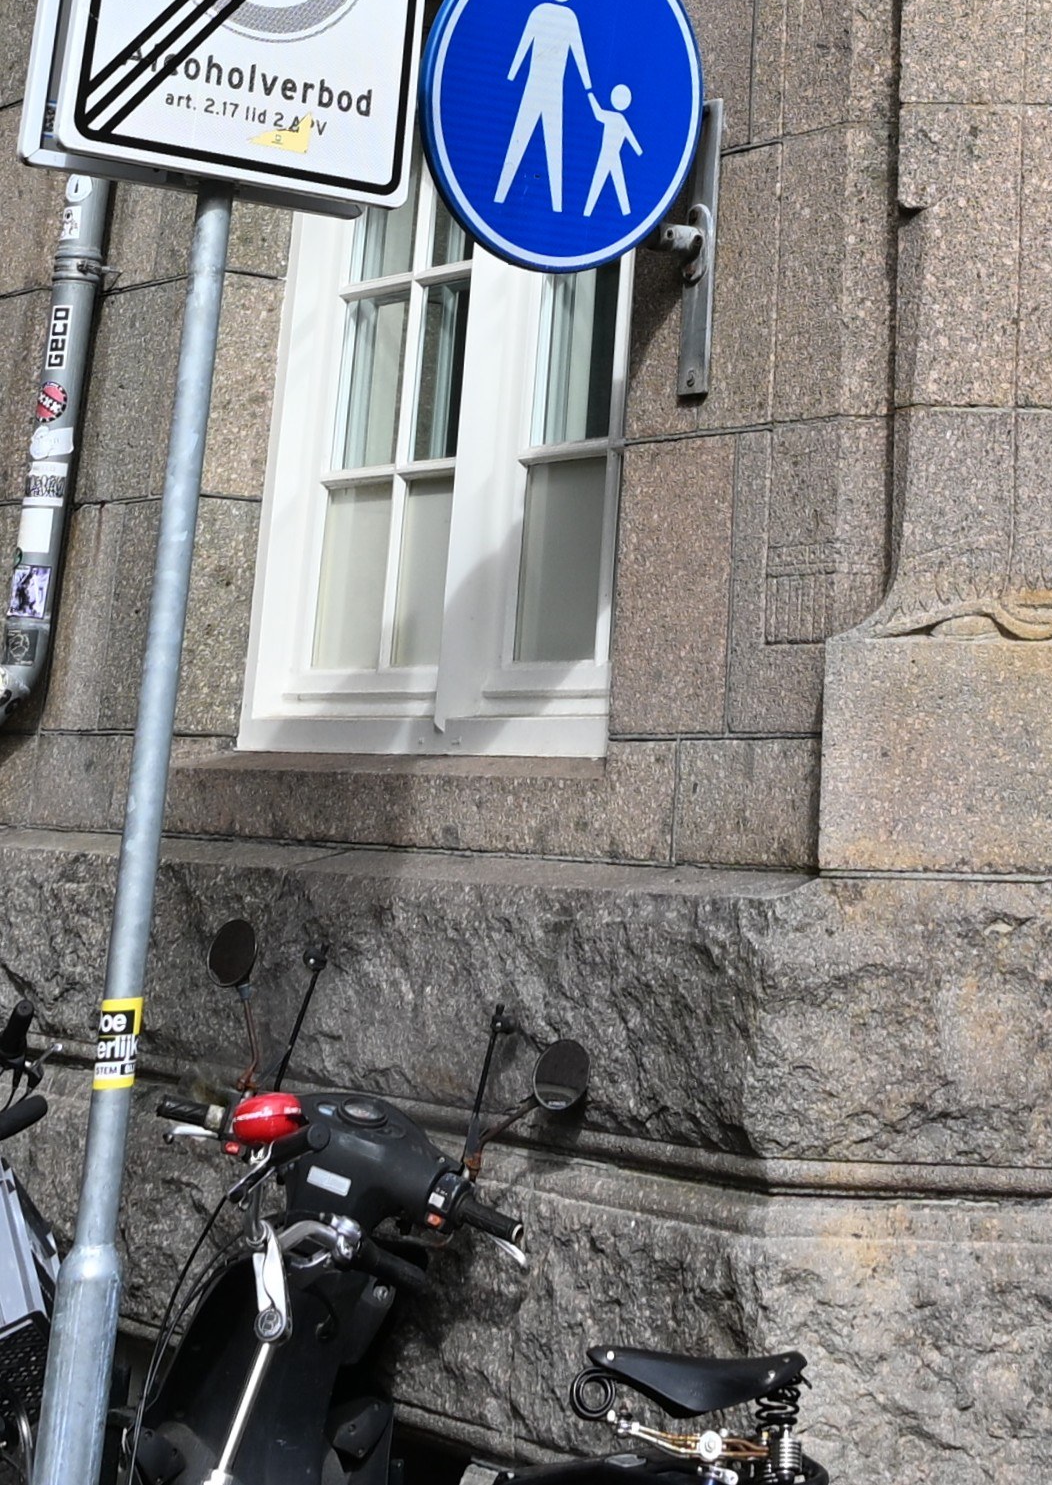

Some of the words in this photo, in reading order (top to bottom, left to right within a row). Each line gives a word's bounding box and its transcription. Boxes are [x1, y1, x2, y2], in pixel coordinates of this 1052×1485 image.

[165, 91, 197, 111] art.
[204, 98, 240, 118] 2.17
[245, 106, 267, 124] lid
[288, 116, 327, 135] AV
[99, 1013, 127, 1032] oe
